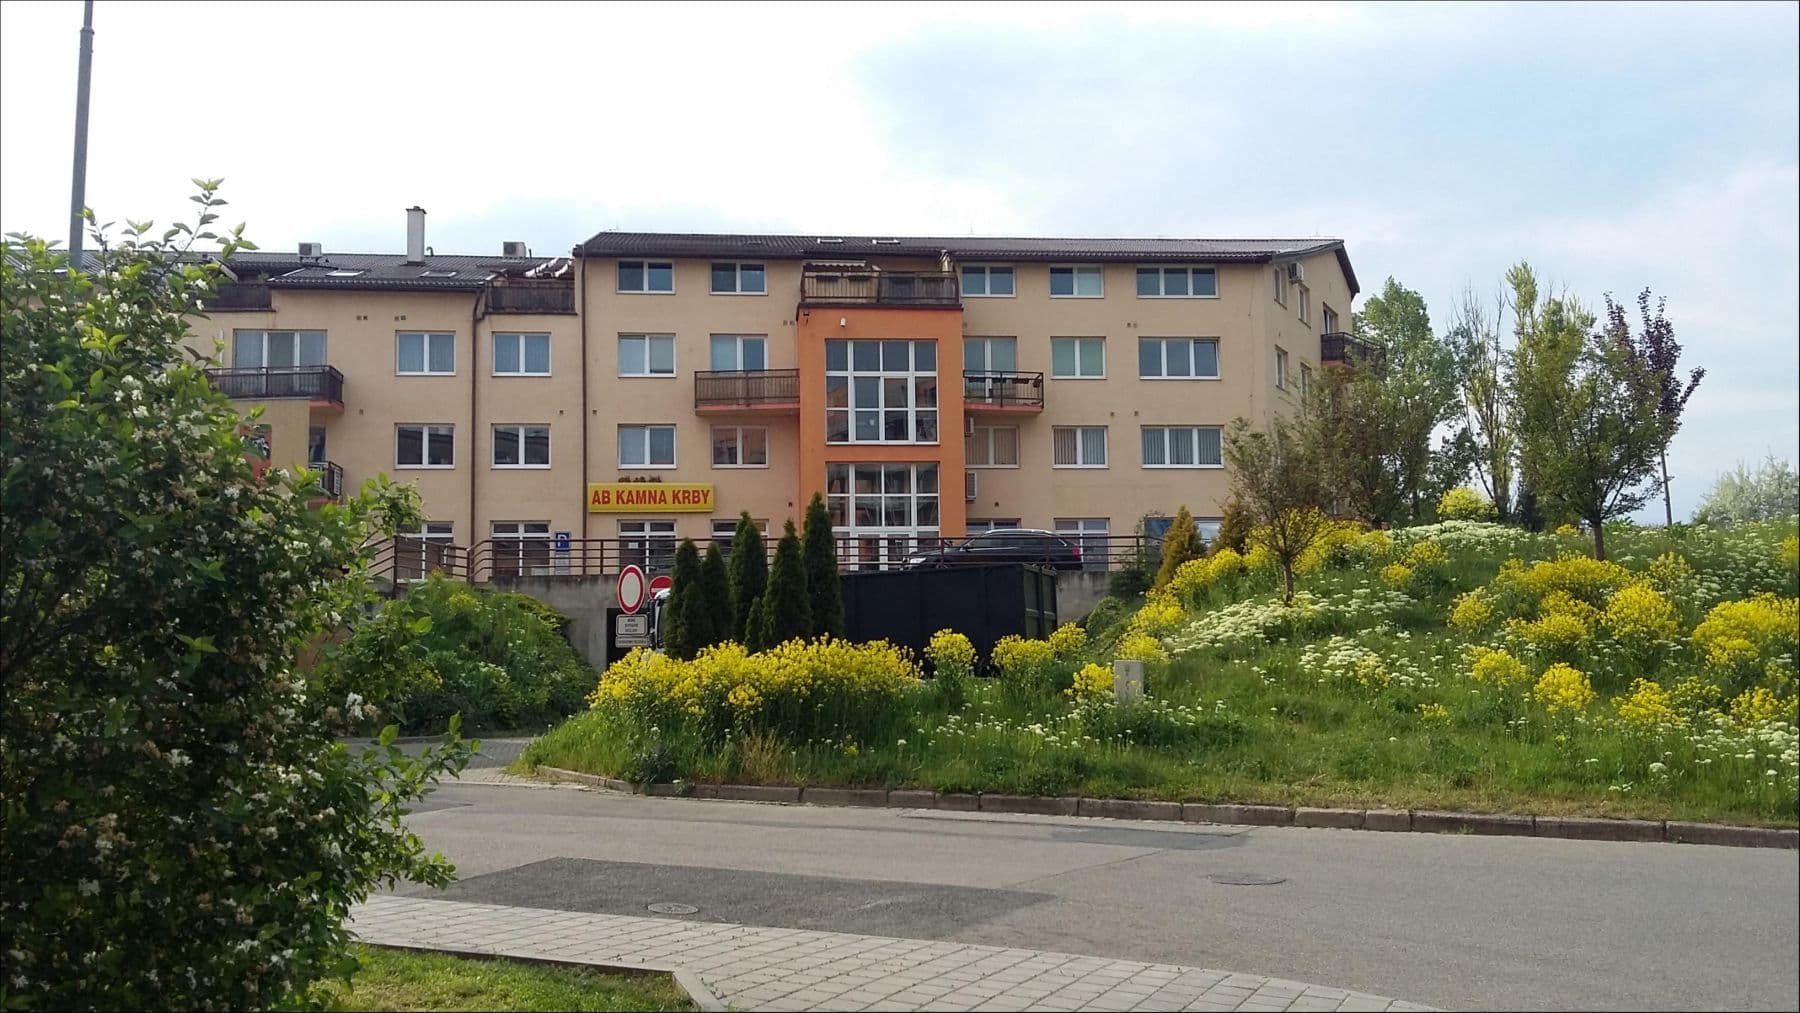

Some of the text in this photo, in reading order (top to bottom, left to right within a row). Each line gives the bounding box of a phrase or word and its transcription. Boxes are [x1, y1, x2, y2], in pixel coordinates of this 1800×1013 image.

[592, 489, 711, 505] AB KAMNA KRBY
[557, 534, 567, 547] P
